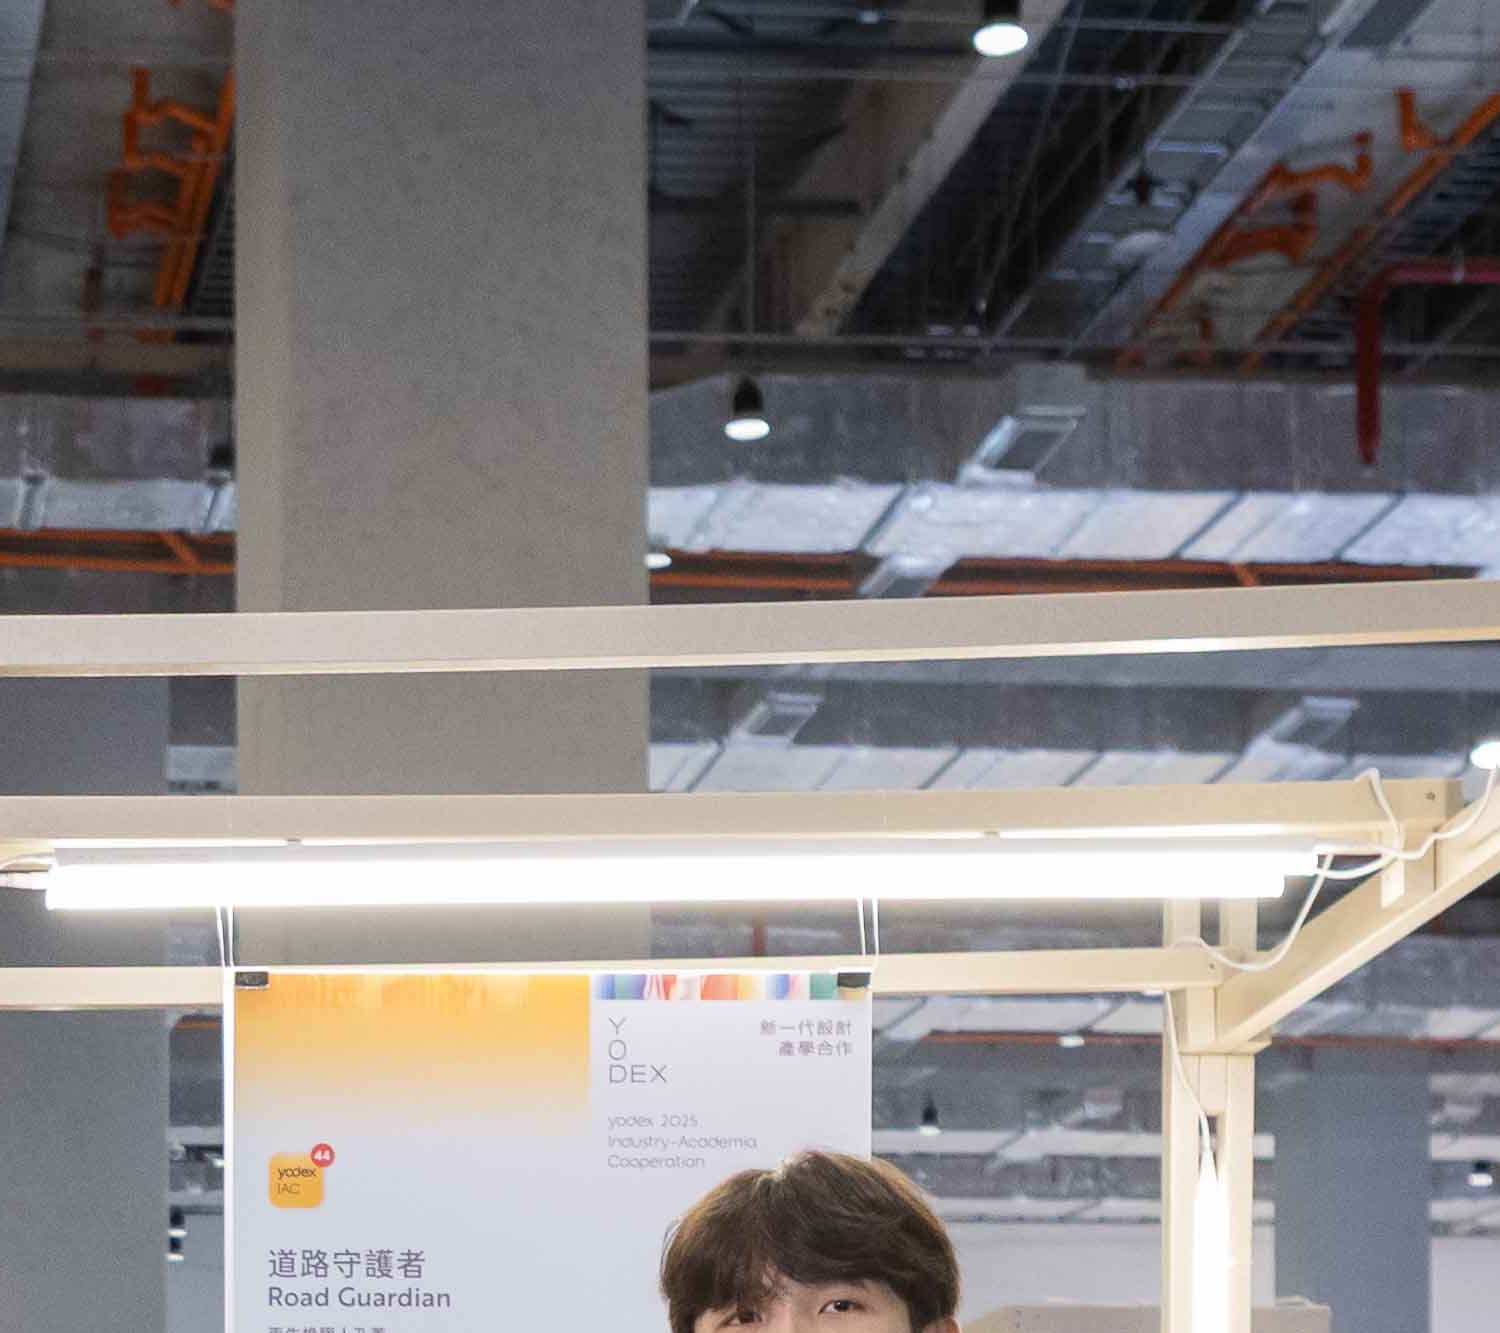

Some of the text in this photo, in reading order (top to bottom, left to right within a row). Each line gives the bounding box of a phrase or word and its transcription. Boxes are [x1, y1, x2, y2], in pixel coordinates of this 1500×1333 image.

[778, 1039, 853, 1057] 產學合作
[609, 1064, 668, 1084] DEX
[607, 1115, 653, 1131] yodex
[608, 1135, 758, 1152] Industry-Academia
[313, 1149, 331, 1161] 44
[607, 1154, 705, 1171] Cooperation
[277, 1166, 317, 1180] yodex
[269, 1249, 425, 1279] 道路守護者
[269, 1286, 451, 1308] Road Guardian
